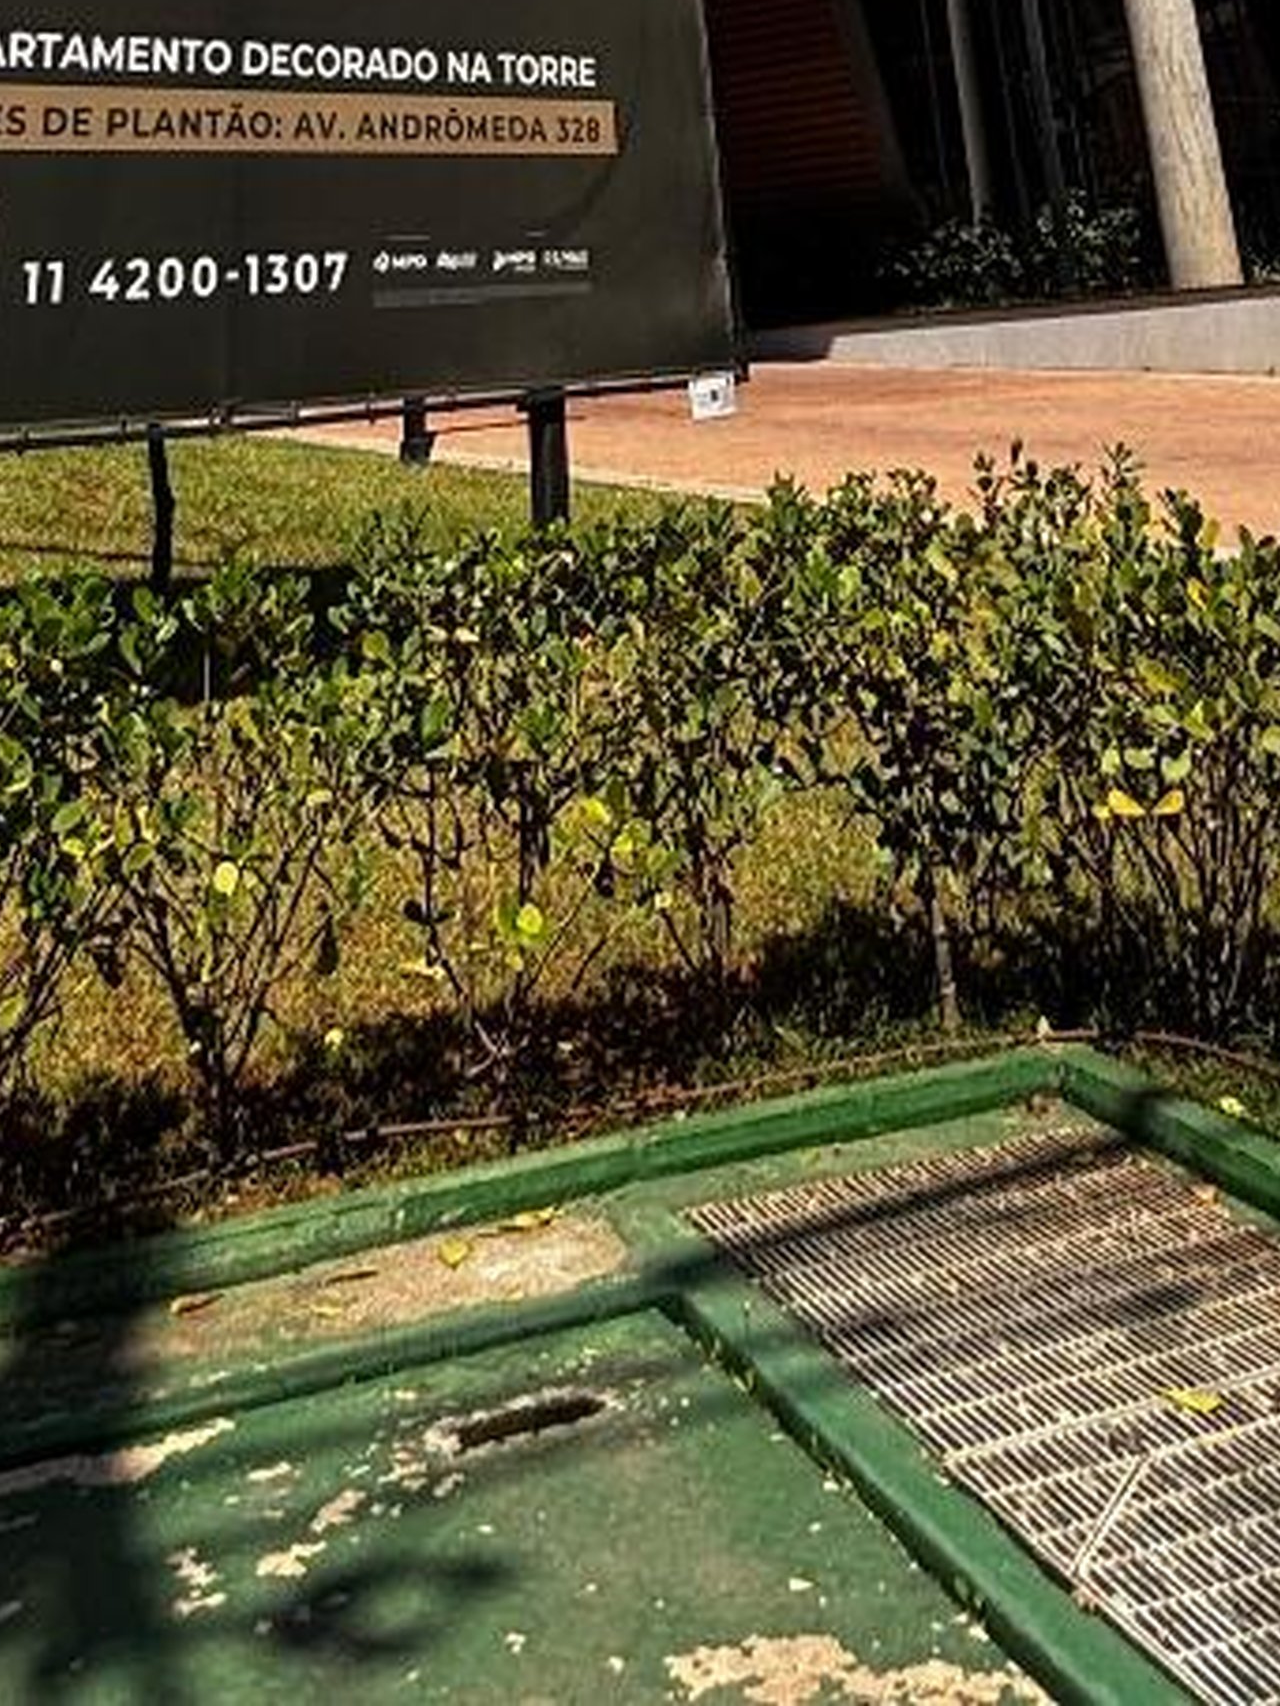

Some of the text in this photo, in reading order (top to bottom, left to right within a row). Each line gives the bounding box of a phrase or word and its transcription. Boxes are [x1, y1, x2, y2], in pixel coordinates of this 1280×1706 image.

[242, 42, 439, 82] DECORADO
[447, 51, 492, 84] NA
[498, 53, 597, 87] TORRE
[42, 107, 93, 137] DE
[107, 103, 282, 140] PLANTÃO:
[293, 113, 346, 140] AV.
[356, 106, 548, 143] ANDRÔMEDA
[557, 116, 601, 144] 328
[23, 260, 64, 304] 11
[88, 253, 349, 301] 4200-1307
